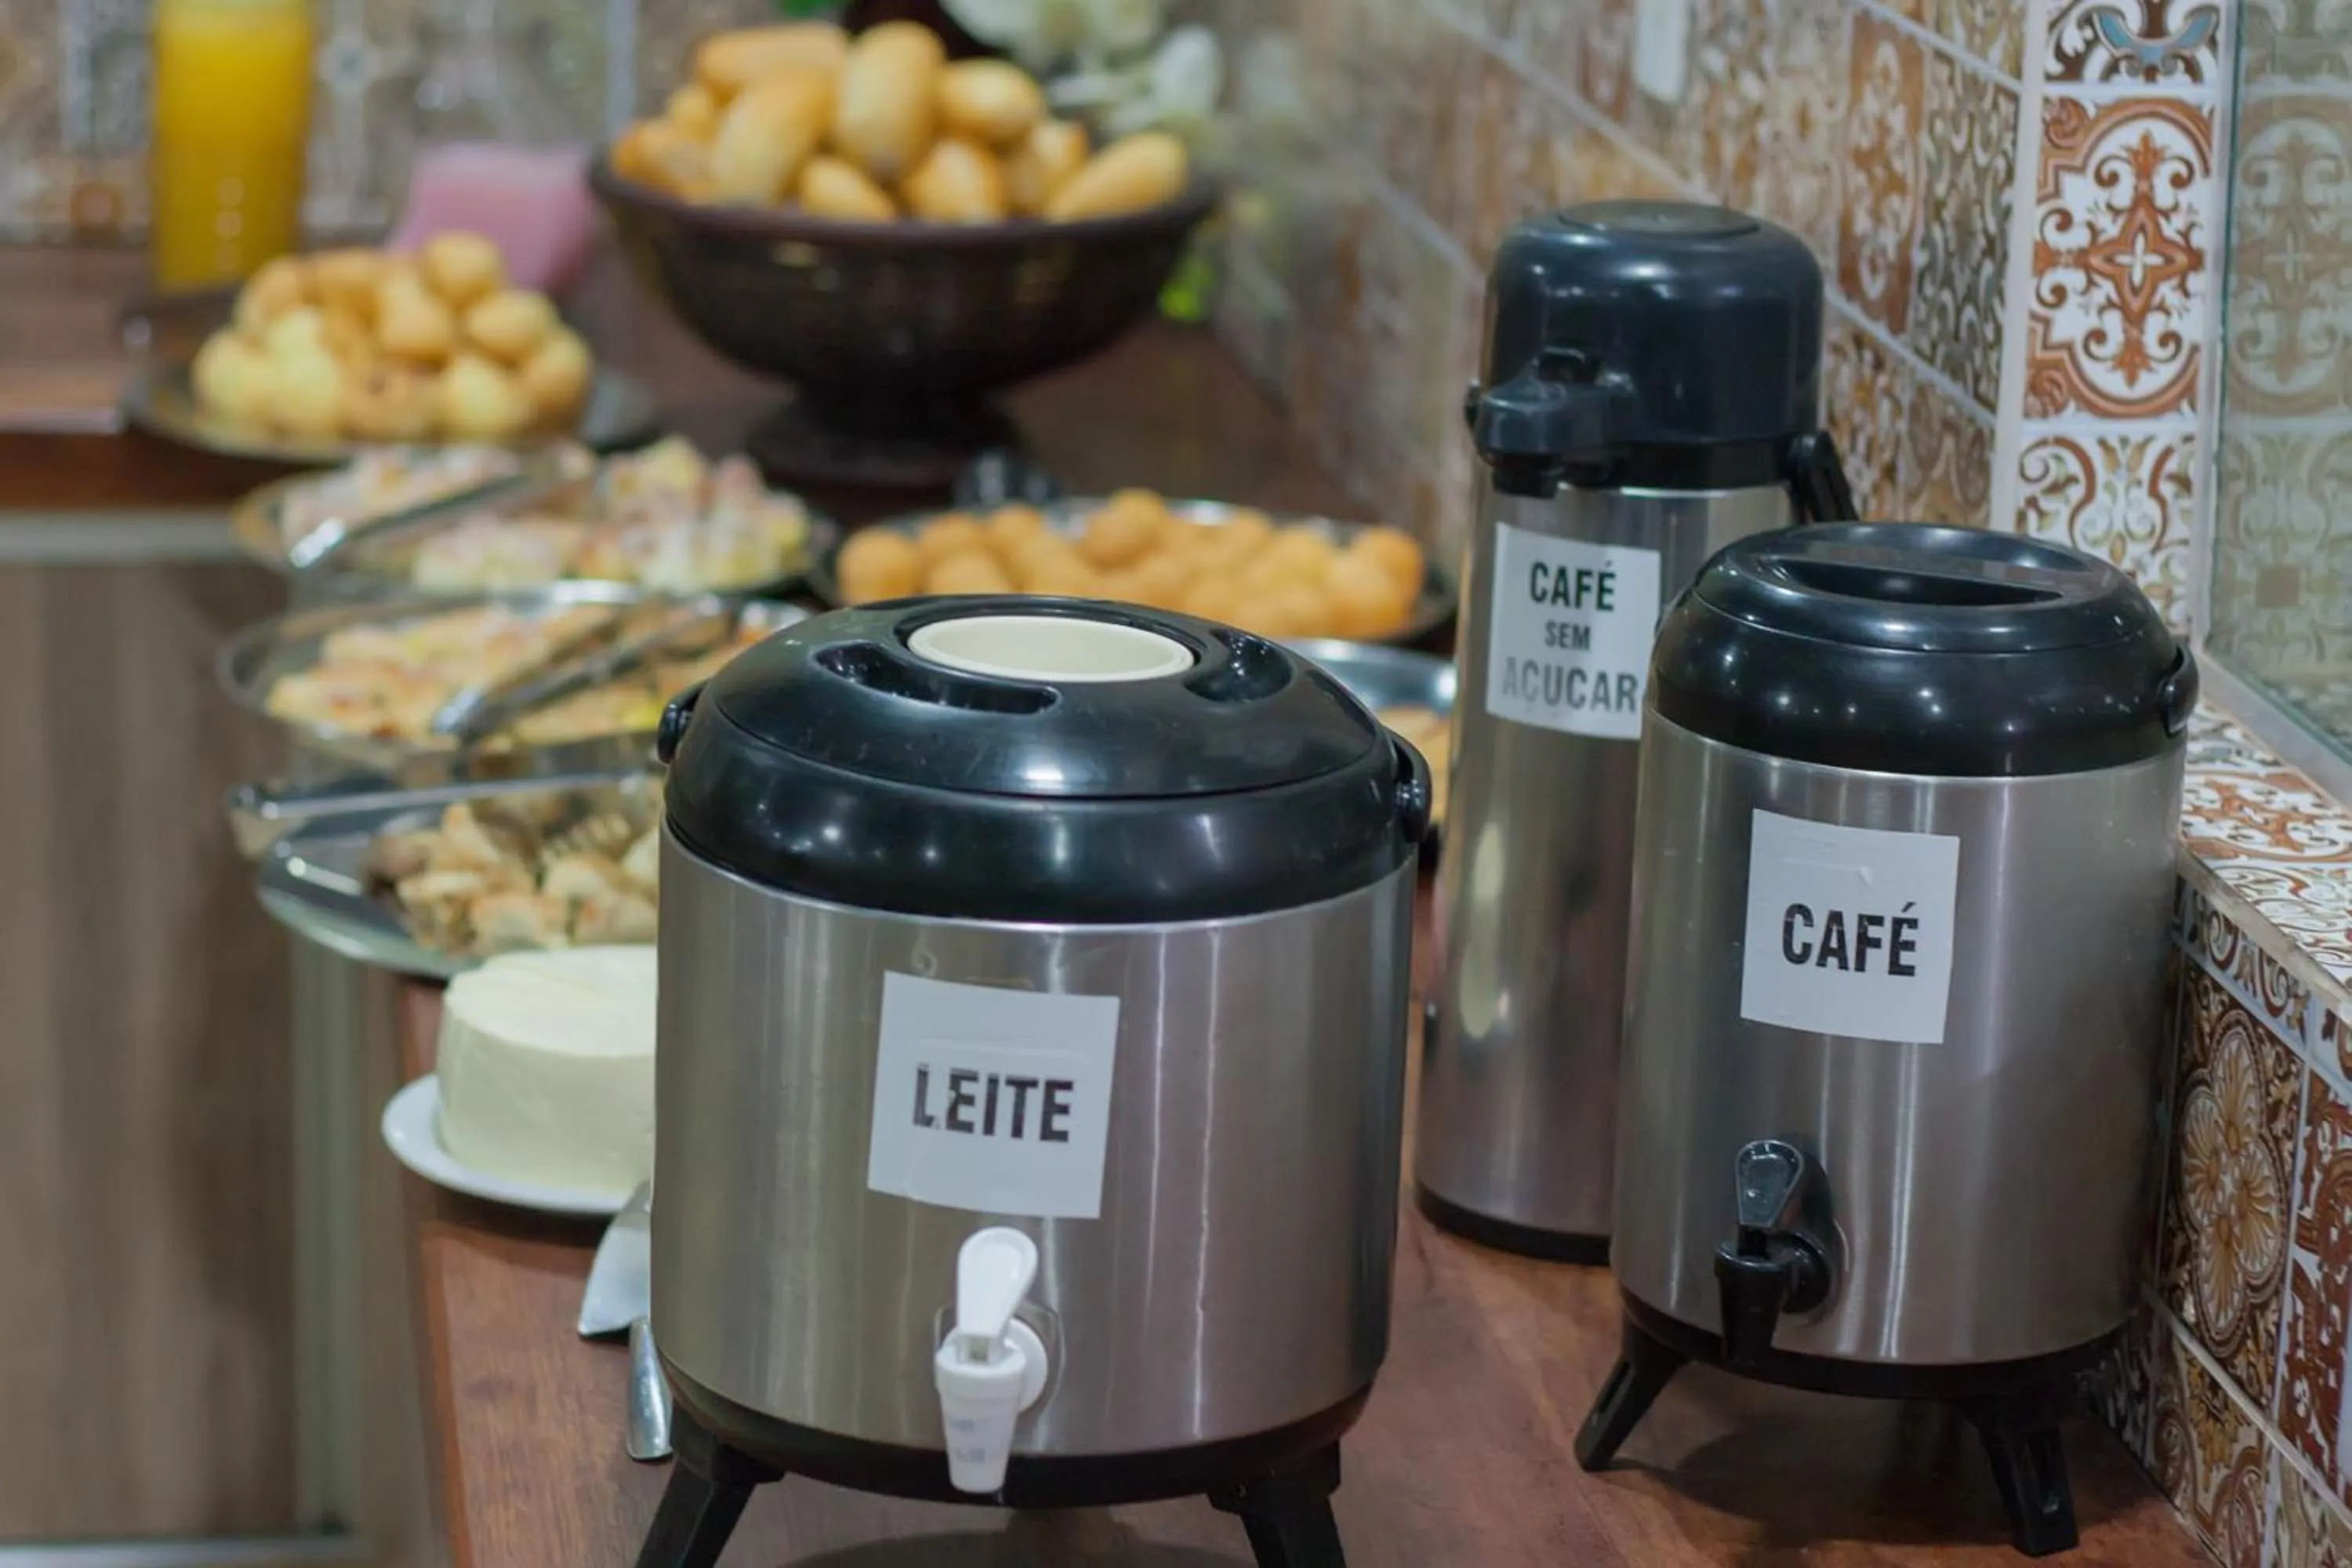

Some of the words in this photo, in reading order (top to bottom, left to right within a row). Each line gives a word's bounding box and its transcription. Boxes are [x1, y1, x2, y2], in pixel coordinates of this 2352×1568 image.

[1530, 560, 1616, 612] CAFÉ
[1544, 620, 1591, 650] SEM
[1782, 902, 1918, 977] CAFÉ
[913, 1063, 1073, 1142] LEITE
